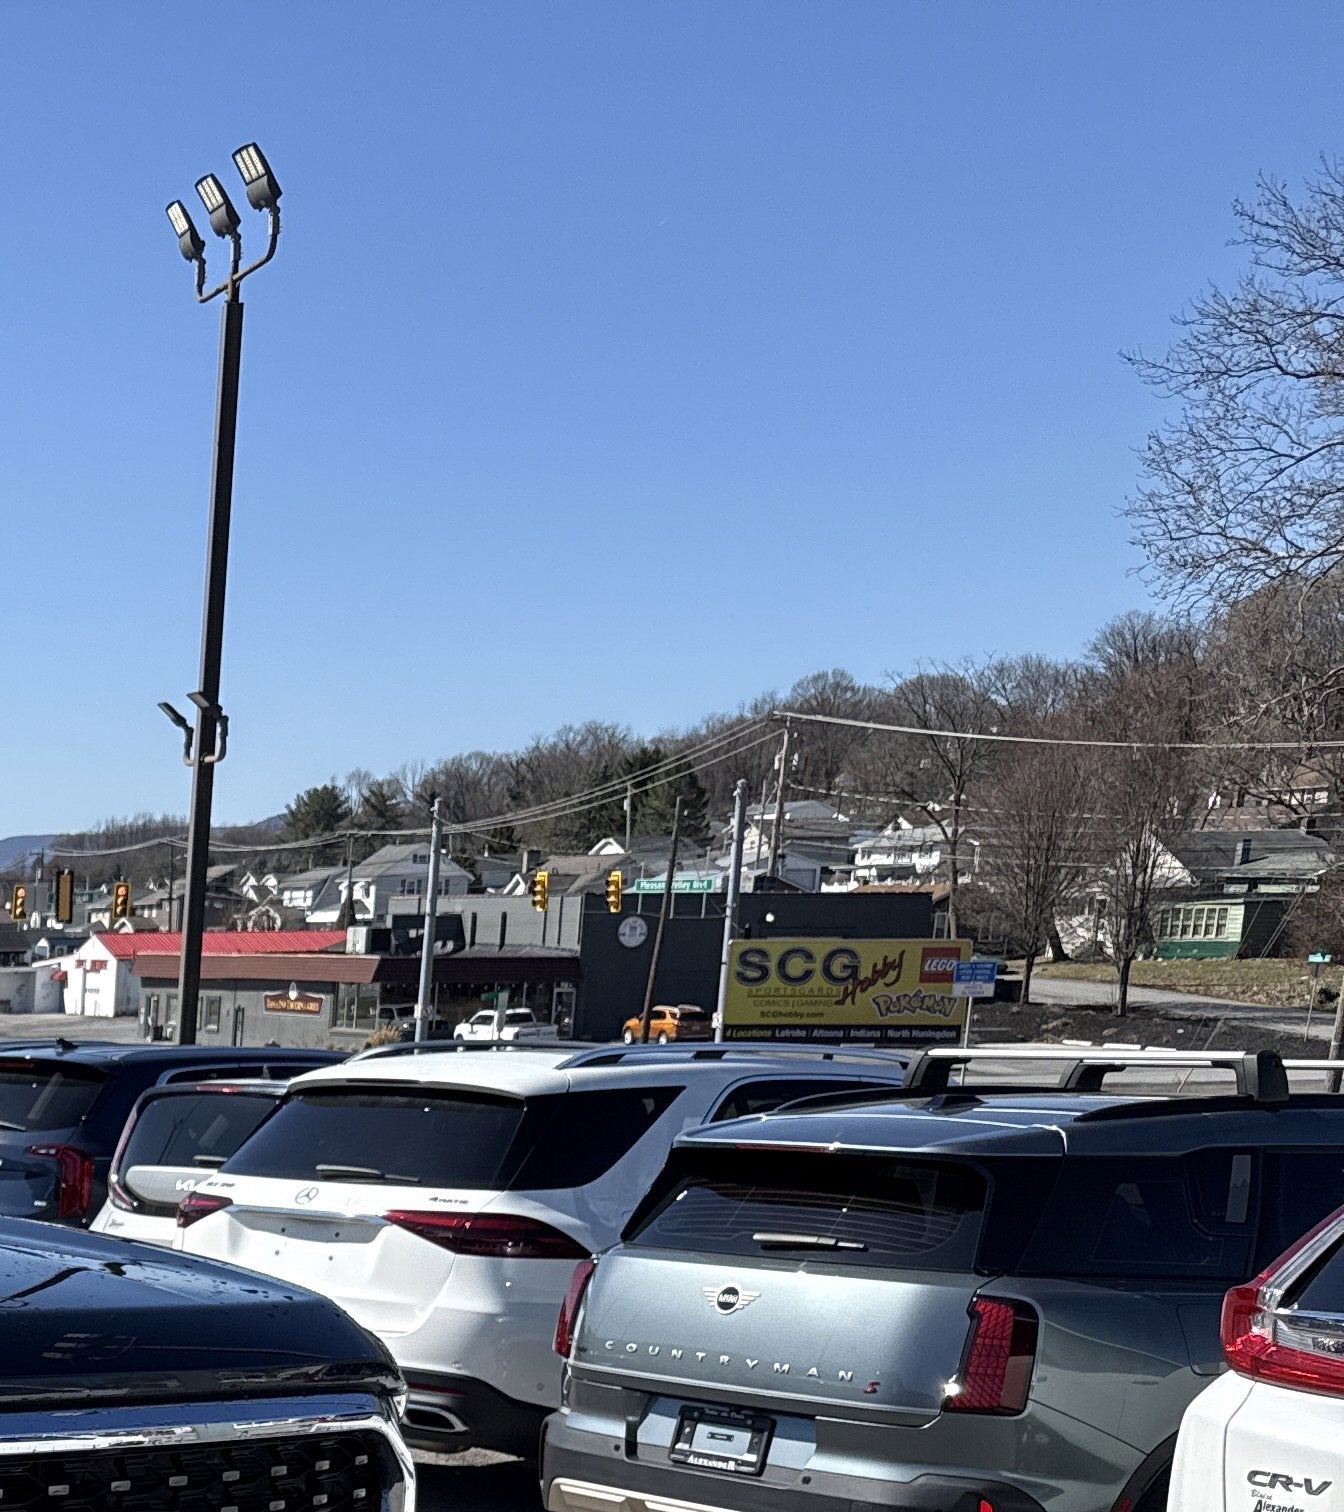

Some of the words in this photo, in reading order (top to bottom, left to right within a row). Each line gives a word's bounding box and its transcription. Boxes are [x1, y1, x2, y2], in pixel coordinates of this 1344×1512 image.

[734, 946, 861, 987] SCG
[834, 950, 906, 1005] Hobby
[924, 958, 957, 972] LEGO
[752, 999, 790, 1007] COMICS
[604, 1340, 854, 1382] COUNTRYMAN
[1247, 1470, 1332, 1496] CR-V
